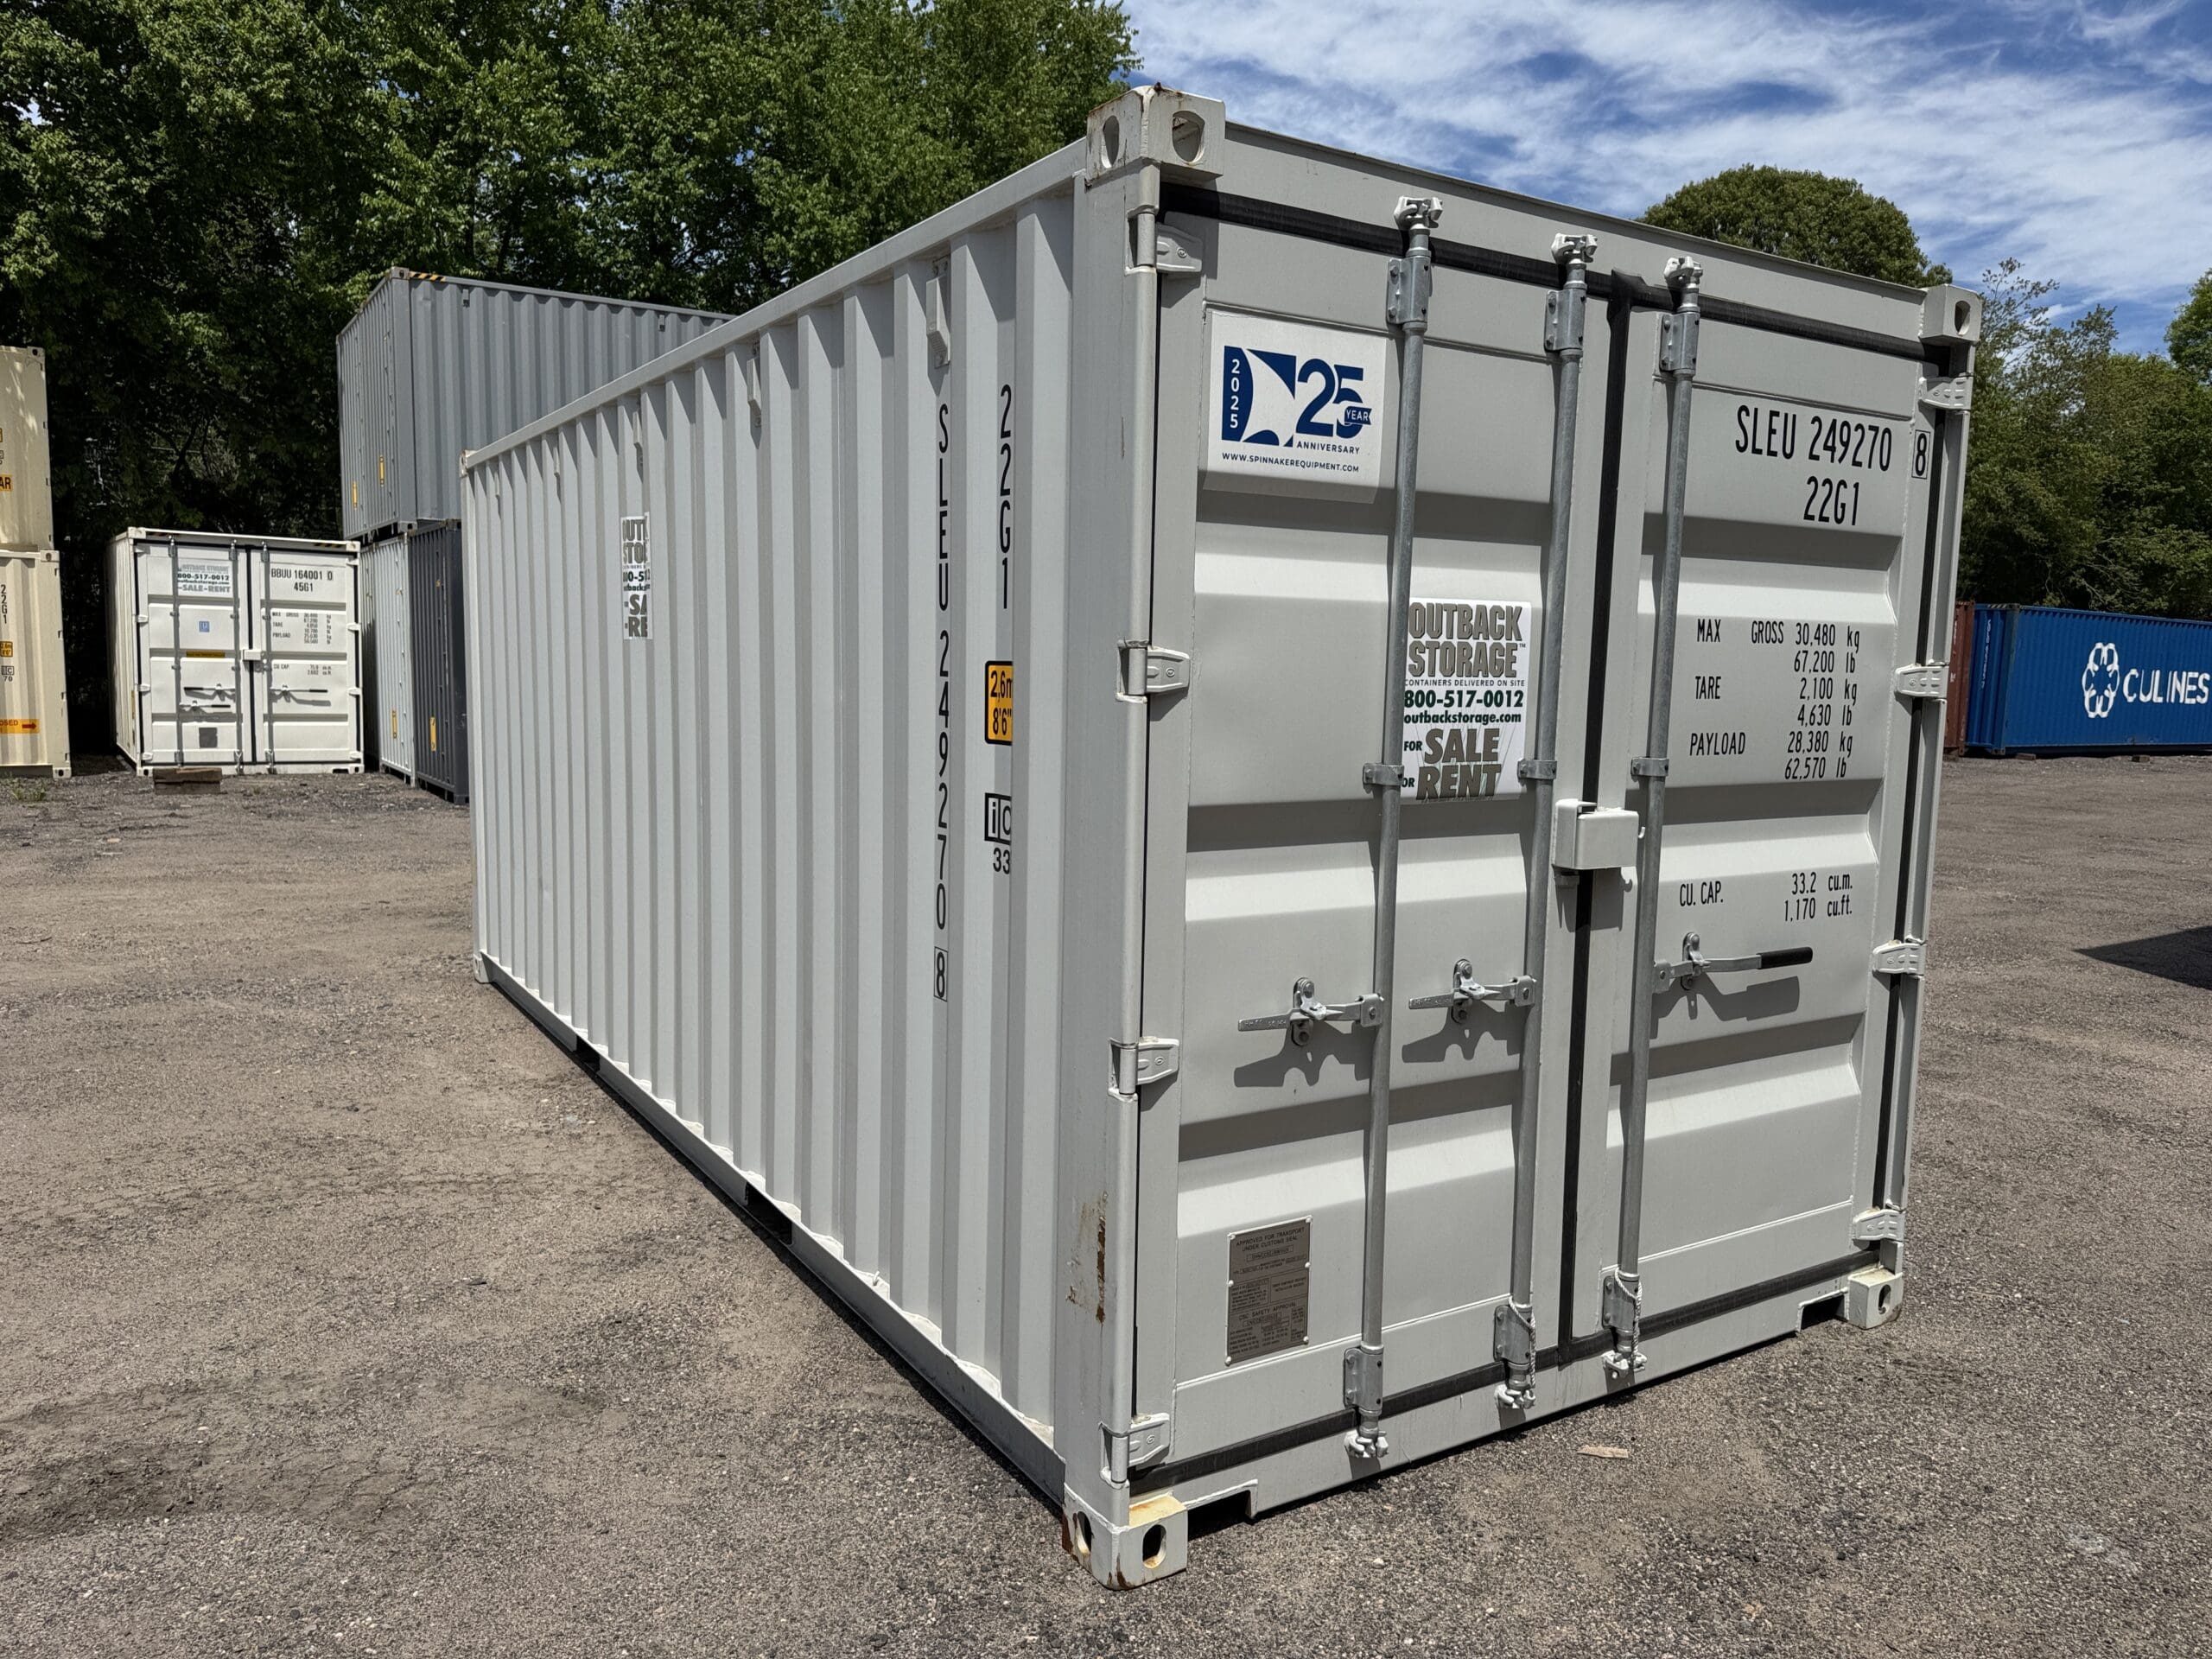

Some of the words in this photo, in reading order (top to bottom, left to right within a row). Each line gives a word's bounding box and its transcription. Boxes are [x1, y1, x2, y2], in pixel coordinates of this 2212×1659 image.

[1230, 359, 1240, 429] 2025
[1296, 358, 1363, 439] 25
[1344, 410, 1370, 422] YEAR
[1296, 441, 1360, 454] ANNIVERSARY
[1735, 404, 1796, 460] SLEU
[1808, 416, 1892, 472] 249270
[1915, 432, 1928, 477] 8
[1222, 452, 1359, 473] WWW.SPINNAKEREQUIPMENT.COM
[938, 403, 949, 612] SLEU
[1000, 384, 1012, 609] 22G1
[1803, 475, 1859, 526] 22G1
[271, 568, 292, 579] BBUU
[294, 569, 322, 581] 164001
[1408, 602, 1523, 641] OUTBACK
[1697, 619, 1721, 643] MAX
[1751, 620, 1784, 645] GROSS
[1795, 622, 1836, 647] 30,480
[1847, 626, 1860, 653] kg
[1408, 640, 1518, 678] STORAGE
[1794, 651, 1834, 674] 67,200
[1846, 652, 1856, 674] lb
[1404, 690, 1524, 709] 800-517-0012
[1695, 676, 1722, 700] TARE
[1799, 677, 1834, 701] 2,100
[1844, 678, 1857, 706] kg
[2123, 669, 2211, 704] CULINES
[1403, 710, 1522, 726] outbackstorage.com
[1797, 703, 1831, 728] 4,630
[1841, 704, 1853, 727] lb
[1403, 741, 1423, 752] FOR
[1424, 728, 1500, 765] SALE
[1689, 732, 1746, 756] PAYLOAD
[1787, 730, 1829, 754] 28,380
[1839, 731, 1853, 758] kg
[936, 629, 950, 930] 249270
[1416, 764, 1502, 800] RENT
[1784, 757, 1826, 780] 62,570
[1836, 757, 1847, 779] lb
[993, 847, 1011, 875] 33
[1679, 883, 1696, 907] CU.
[1700, 880, 1724, 905] CAP.
[1791, 871, 1817, 895] 33.2
[1827, 873, 1853, 892] cu.m.
[1783, 897, 1815, 922] 1,170
[1827, 894, 1853, 918] cu.ft.
[936, 951, 945, 998] 8
